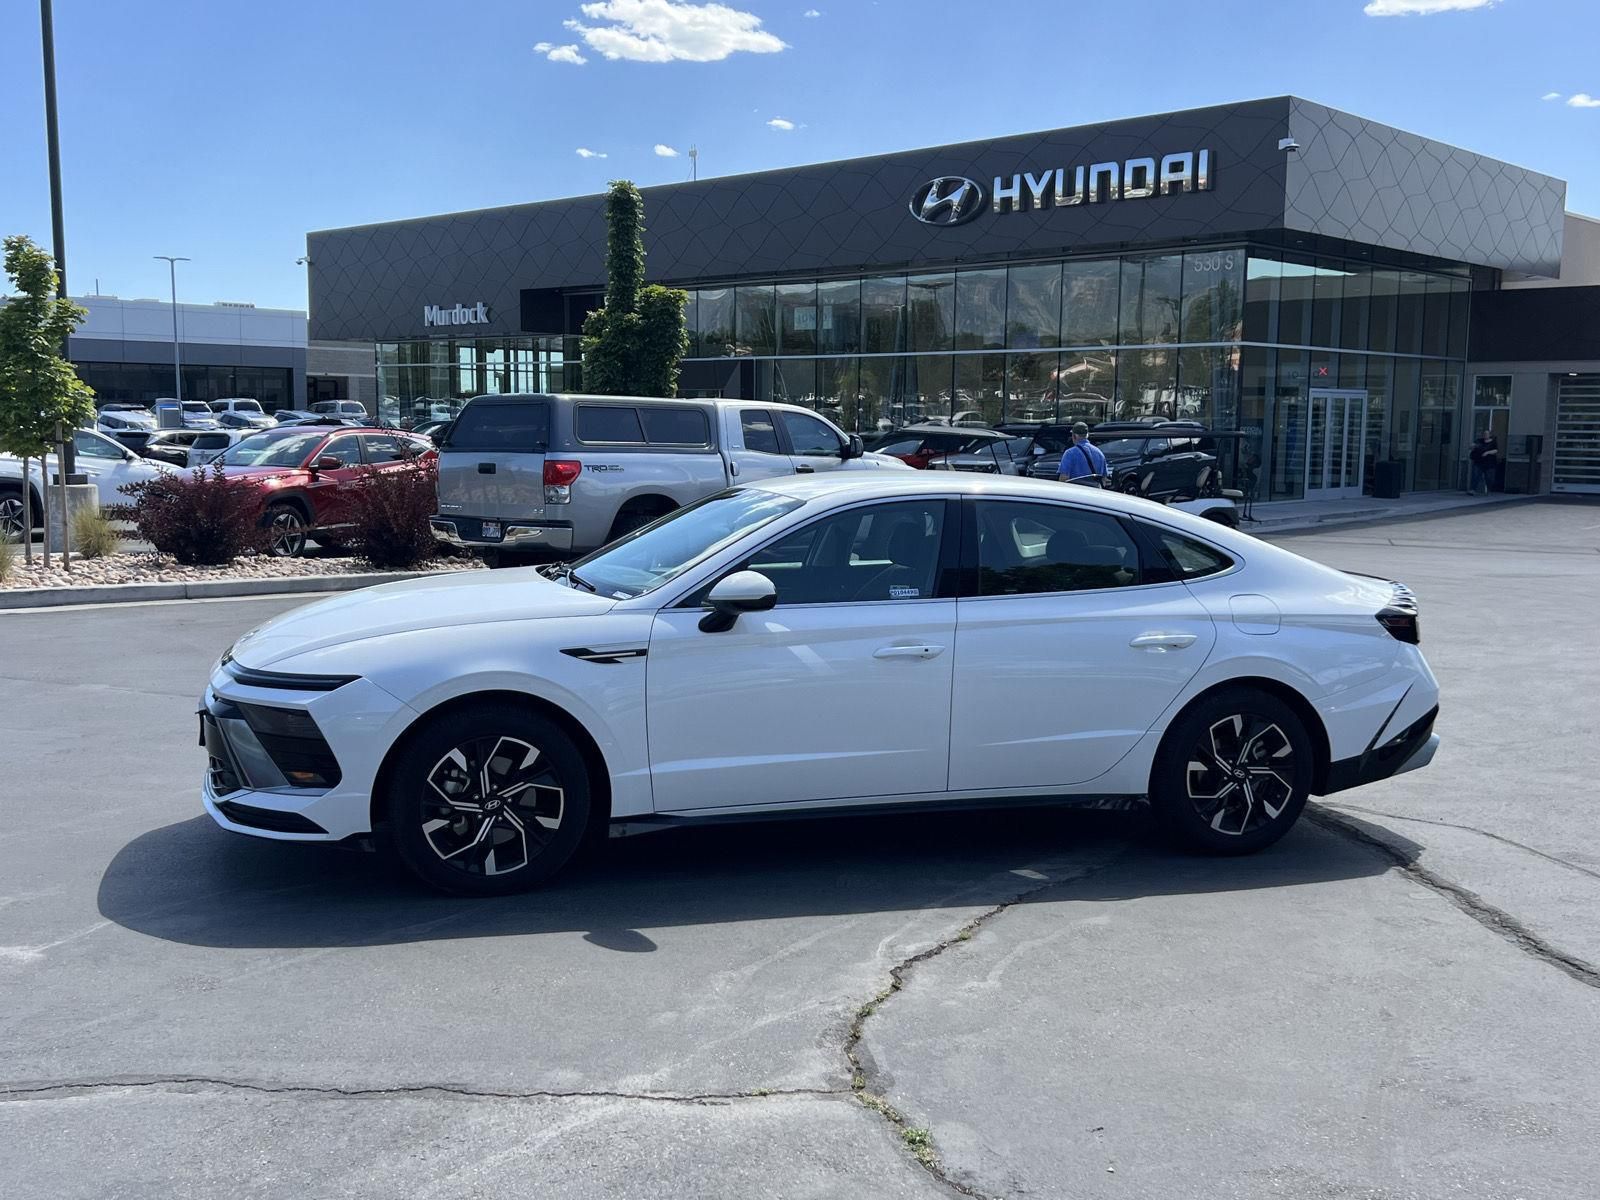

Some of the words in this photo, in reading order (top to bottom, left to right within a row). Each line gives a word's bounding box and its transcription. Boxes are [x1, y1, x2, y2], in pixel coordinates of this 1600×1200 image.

[993, 149, 1209, 213] HYUNDAI
[1194, 255, 1221, 271] 530
[1225, 254, 1234, 270] S
[424, 302, 490, 326] Murdock
[584, 464, 608, 472] TRD
